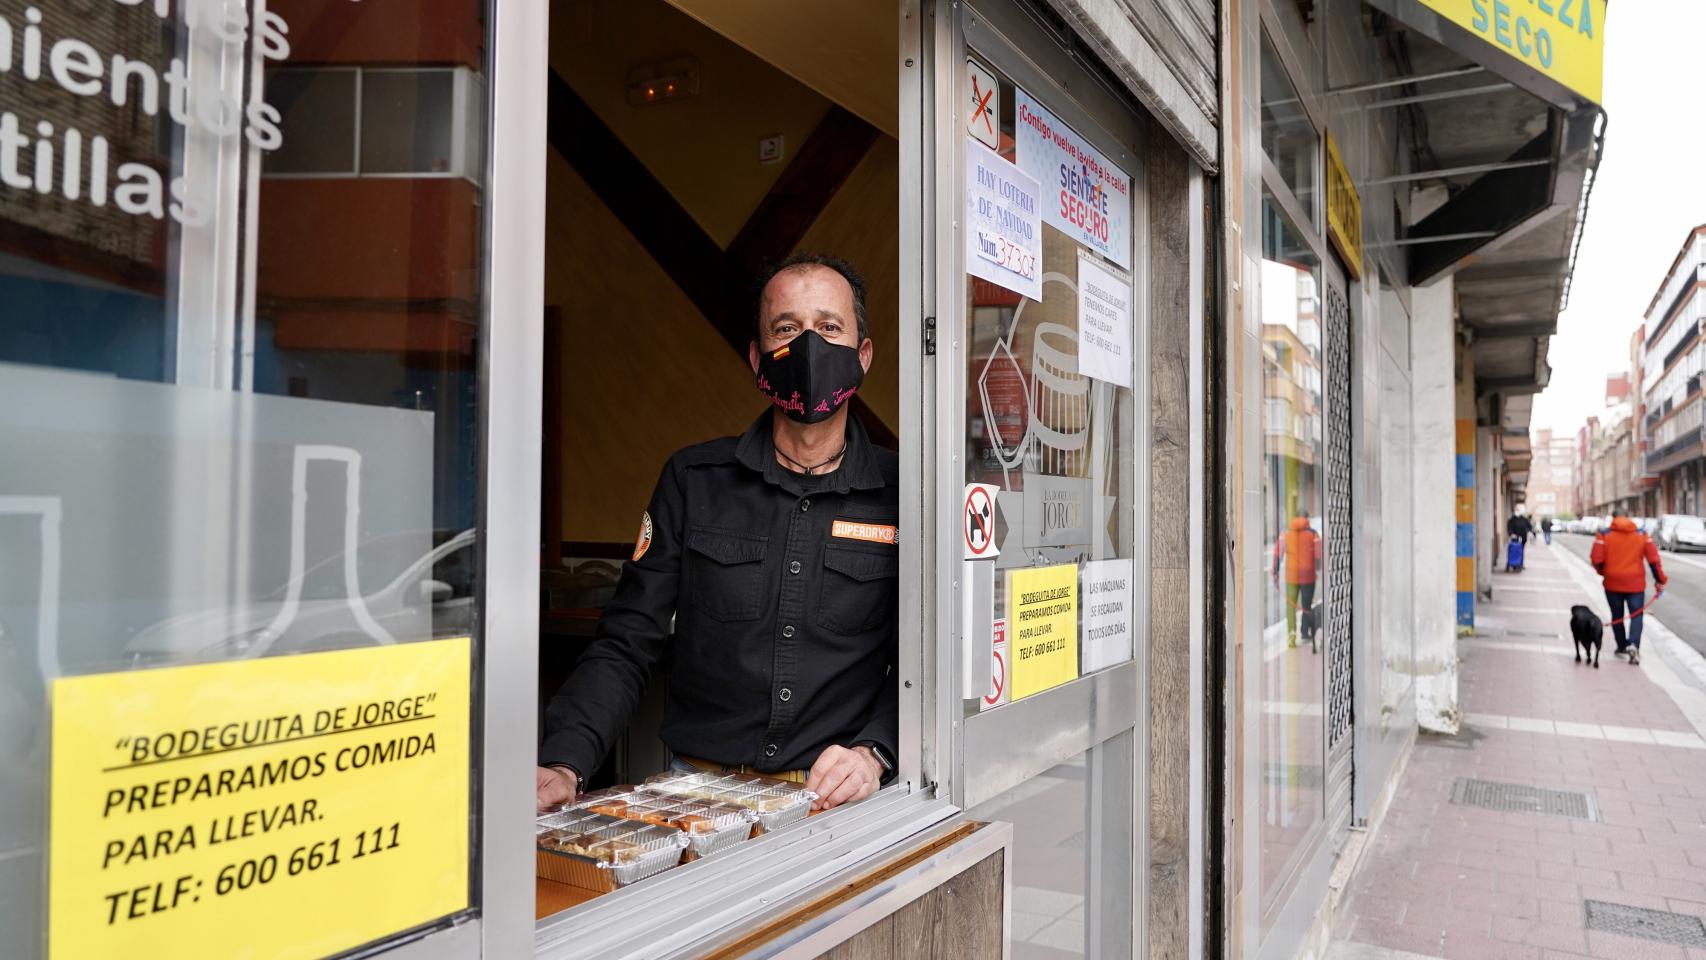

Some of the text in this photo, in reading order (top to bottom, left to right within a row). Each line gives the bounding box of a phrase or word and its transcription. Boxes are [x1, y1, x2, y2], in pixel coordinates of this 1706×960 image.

[1472, 0, 1552, 69] SECO
[1053, 131, 1076, 156] vuelve
[1104, 168, 1111, 182] la
[1112, 174, 1127, 196] calle!
[977, 165, 1034, 215] HAY LOTERIA
[979, 197, 1032, 240] DE NAVIDAD
[1060, 190, 1108, 243] SEGURO
[978, 231, 998, 259] Núm.
[1084, 296, 1105, 316] TENEMOS
[1085, 314, 1097, 328] PARA
[1048, 588, 1056, 600] DE
[1089, 578, 1126, 595] LAS MÁQUINAS
[1019, 602, 1071, 622] PREPARAMOS COMIDA
[1090, 601, 1124, 618] SE RECAUDAN
[1019, 627, 1033, 640] PARA
[1088, 622, 1126, 641] TODOS LOS DÍAS
[1019, 637, 1066, 661] TELF: 600 661 111
[313, 709, 348, 733] DE
[102, 733, 436, 818] PREPARAMOS COMIDA
[102, 798, 324, 870] PARA LLEVAR.
[104, 822, 401, 926] TELF: 600 661 111
